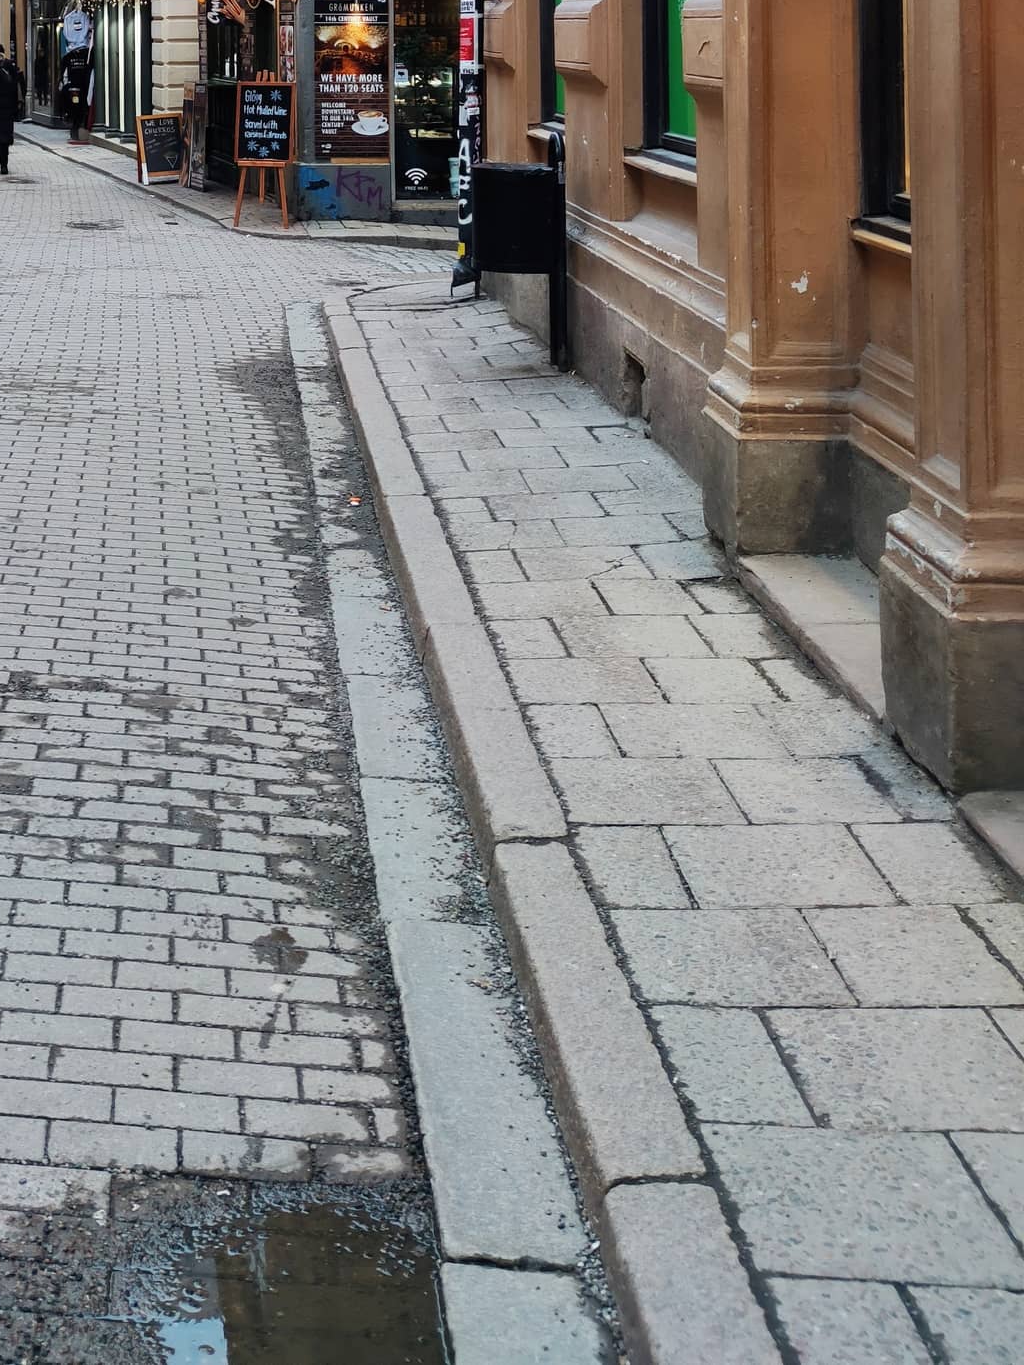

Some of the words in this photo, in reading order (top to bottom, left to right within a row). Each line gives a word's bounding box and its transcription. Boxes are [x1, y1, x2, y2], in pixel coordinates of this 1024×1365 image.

[320, 73, 333, 83] WE
[335, 73, 356, 83] HAVE
[359, 73, 383, 83] MORE
[319, 84, 341, 93] THAN
[344, 84, 359, 93] 120
[361, 84, 384, 93] SEATS
[243, 104, 256, 115] Hot
